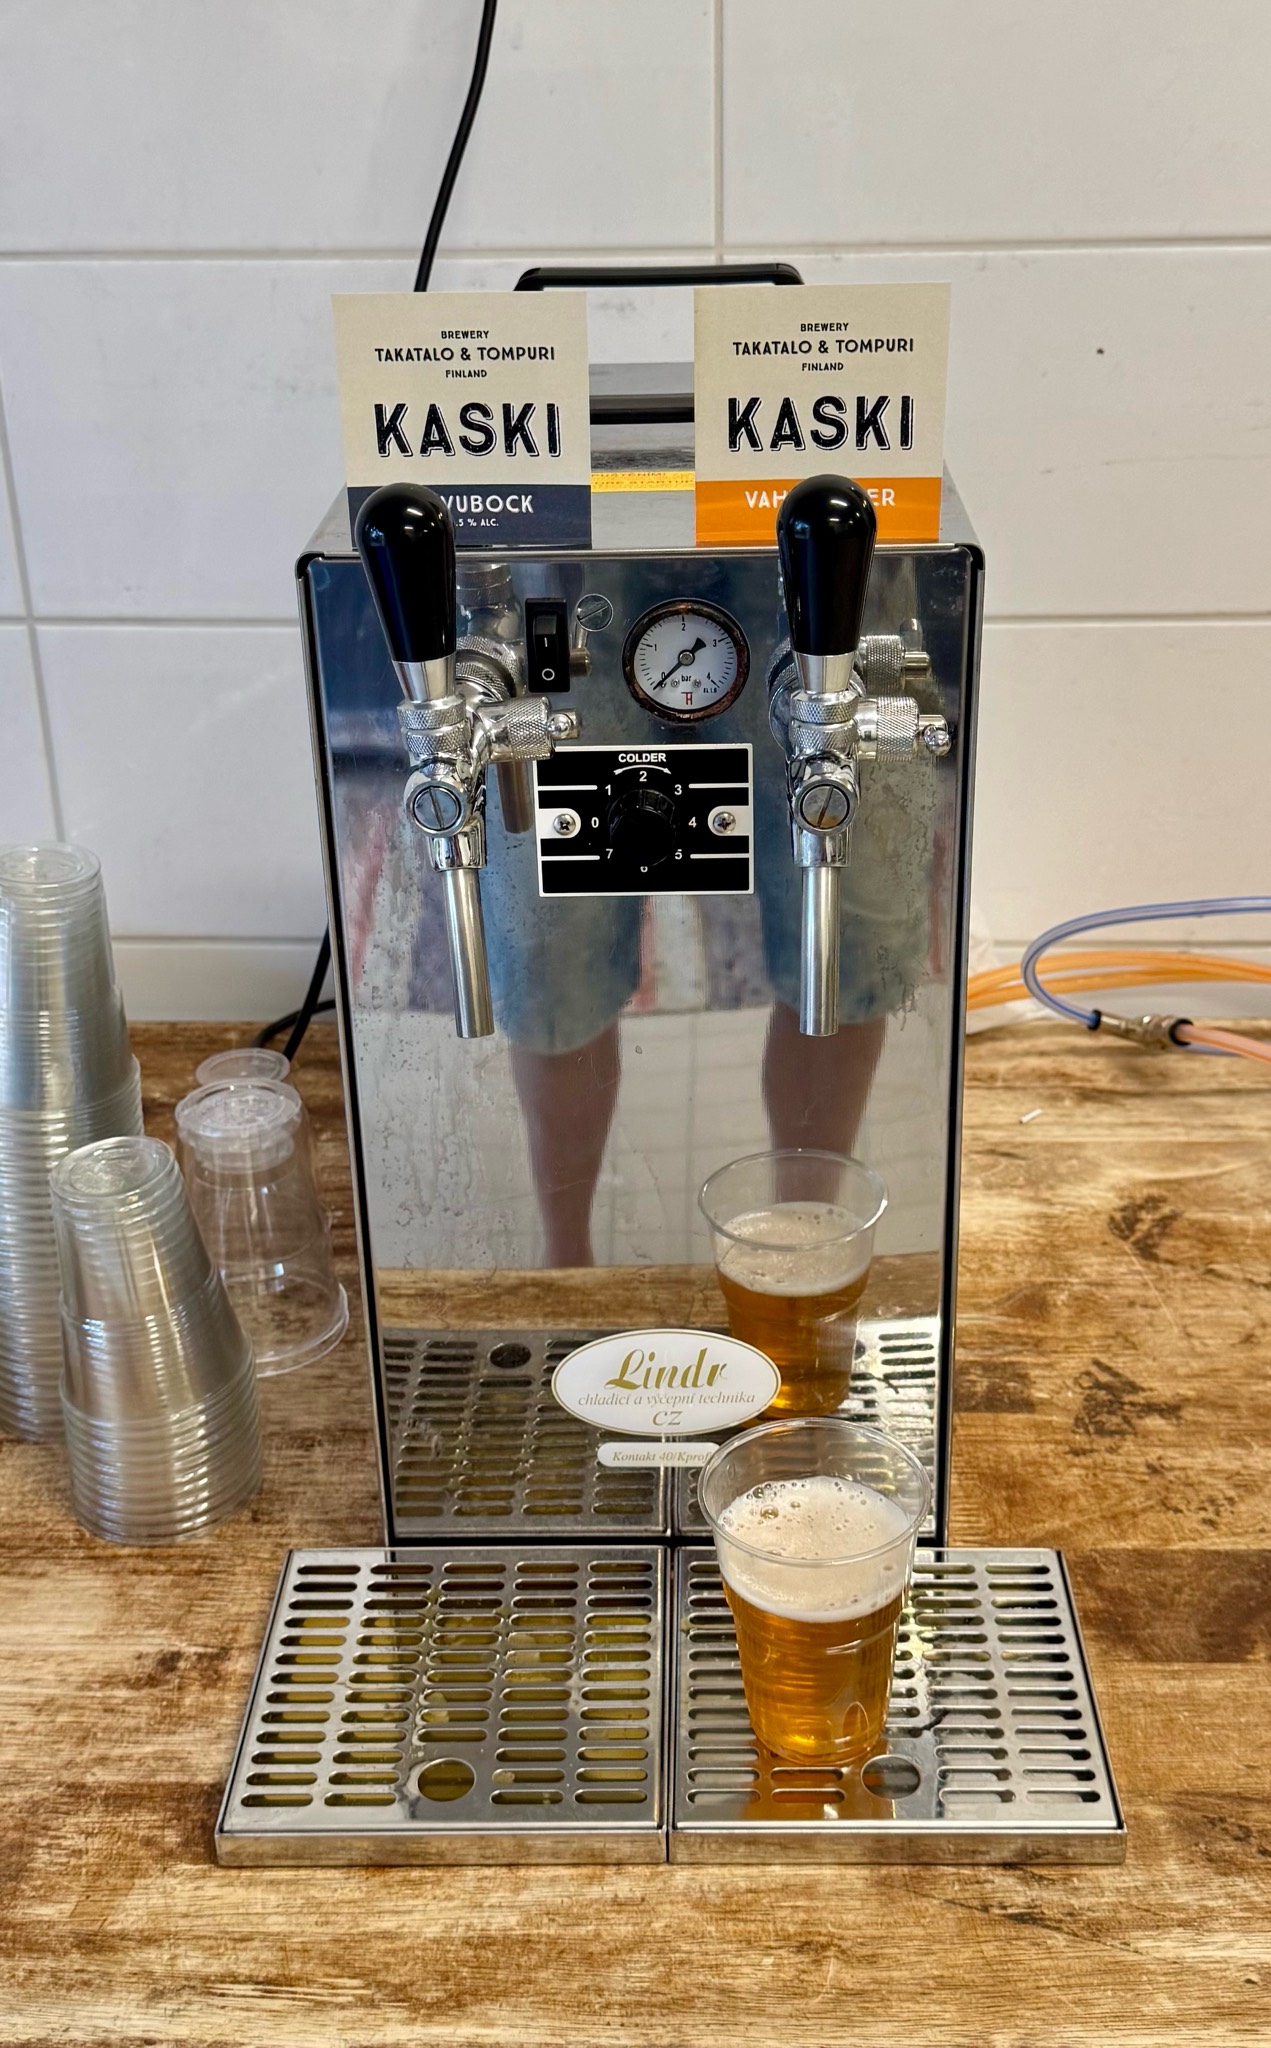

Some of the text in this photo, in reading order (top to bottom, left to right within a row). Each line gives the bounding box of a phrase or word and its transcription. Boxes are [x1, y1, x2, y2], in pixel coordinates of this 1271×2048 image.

[800, 322, 849, 332] BREWERY
[440, 330, 490, 340] BREWERY
[732, 338, 914, 356] TAKATALO & TOMPURI
[374, 346, 555, 362] TAKATALO & TOMPURI
[801, 362, 844, 372] FINLAND
[445, 369, 487, 379] FINLAND
[727, 395, 914, 452] KASKI
[373, 402, 561, 458] KASKI
[440, 494, 534, 514] VUBOCK
[480, 518, 499, 527] ALC.
[681, 623, 686, 631] 2
[618, 753, 667, 763] COLDER
[639, 771, 648, 782] 2
[605, 785, 612, 796] 1
[674, 784, 683, 795] 3
[591, 817, 599, 828] 0
[688, 817, 697, 828] 4
[605, 849, 614, 859] 7
[674, 849, 683, 860] 5
[603, 1348, 728, 1390] Lindr
[634, 1397, 642, 1405] a
[699, 1392, 756, 1404] technika
[652, 1411, 683, 1426] CZ
[612, 1451, 656, 1462] Kontakt
